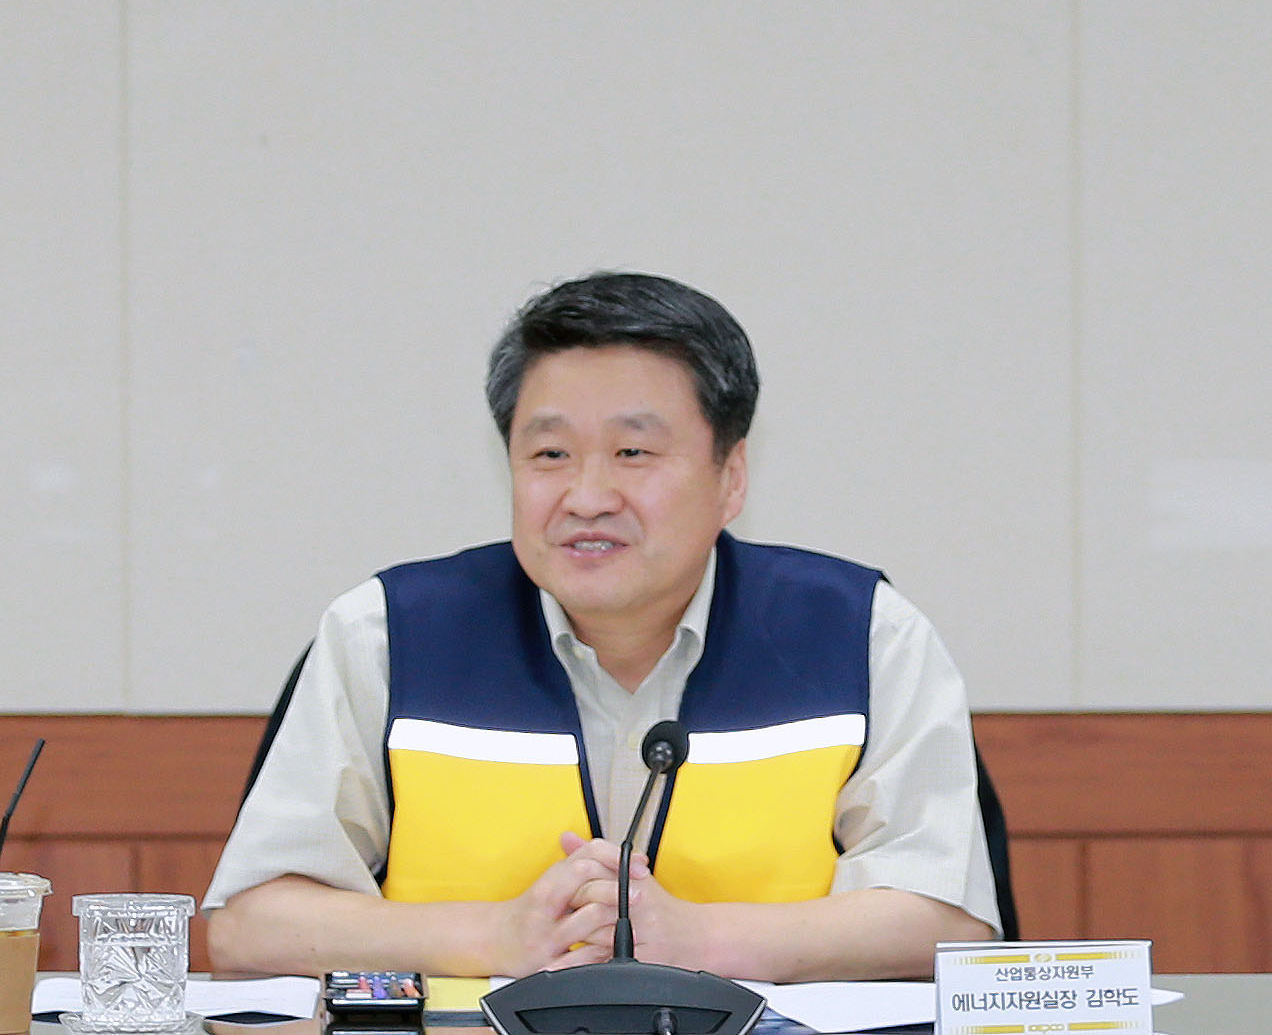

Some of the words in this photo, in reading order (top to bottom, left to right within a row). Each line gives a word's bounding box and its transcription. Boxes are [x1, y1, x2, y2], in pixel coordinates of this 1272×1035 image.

[994, 965, 1095, 982] 산업통상자원부
[951, 991, 1078, 1012] 에너지자원실장
[1086, 988, 1140, 1008] 김학도
